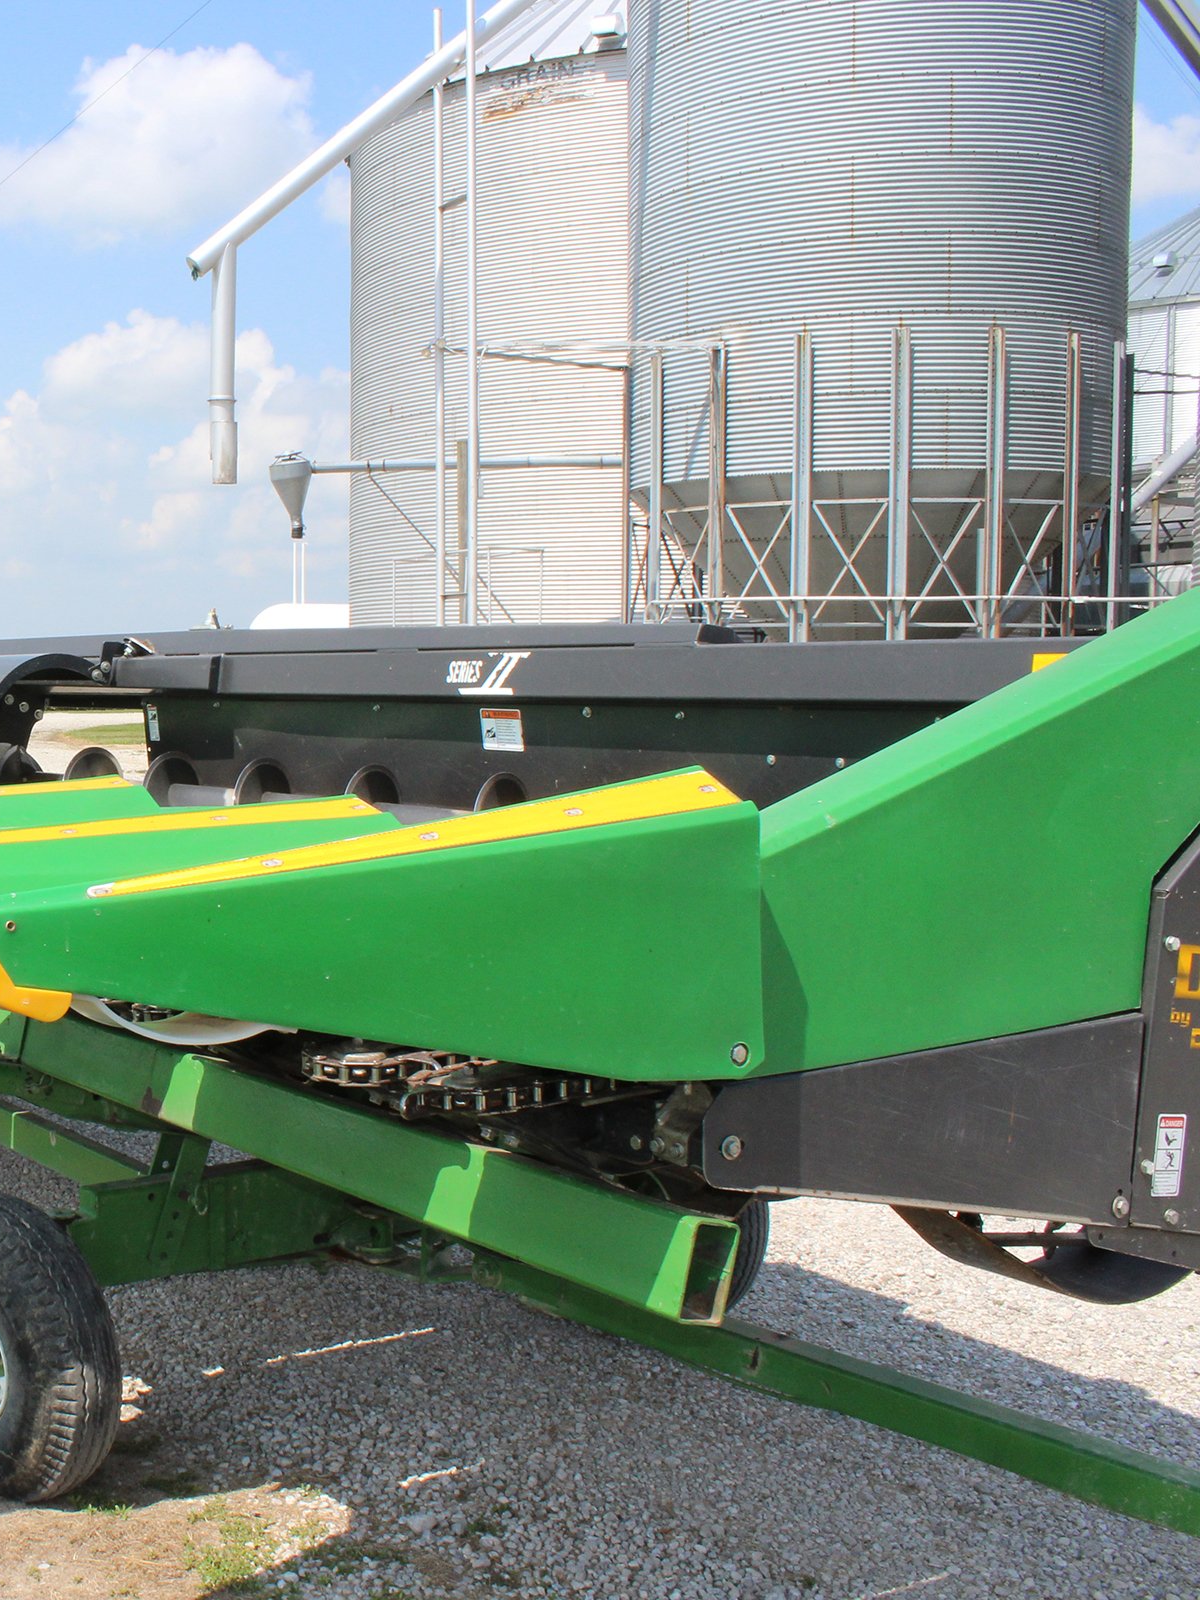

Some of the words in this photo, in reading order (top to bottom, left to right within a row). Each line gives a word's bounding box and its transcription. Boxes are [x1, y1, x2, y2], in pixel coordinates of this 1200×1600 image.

[446, 660, 483, 683] SERIES
[458, 651, 531, 695] II
[1170, 1007, 1191, 1027] by
